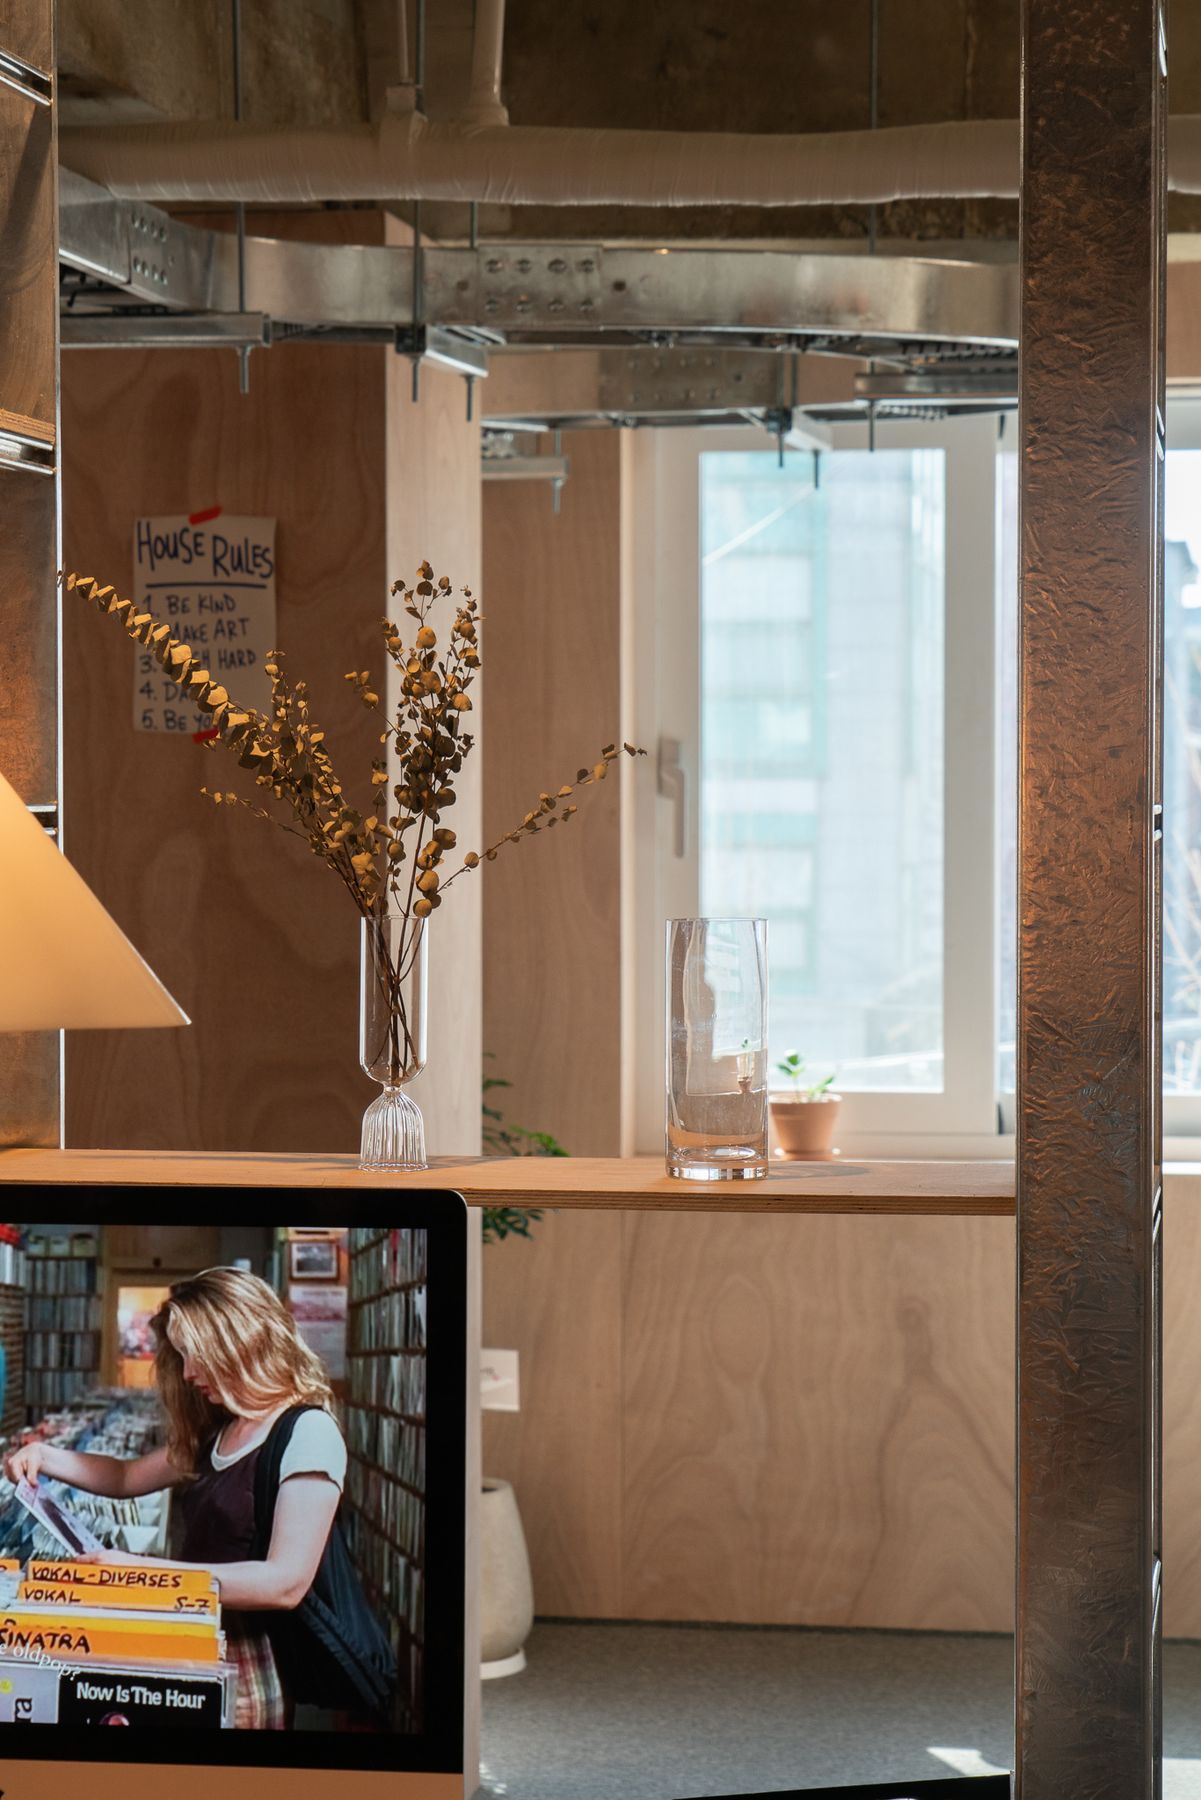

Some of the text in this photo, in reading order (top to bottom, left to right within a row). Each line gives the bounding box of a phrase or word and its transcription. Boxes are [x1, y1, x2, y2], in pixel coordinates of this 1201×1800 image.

[137, 521, 273, 578] HOUSE RULES
[166, 594, 190, 615] BE
[198, 593, 236, 615] KIND
[170, 618, 250, 643] MAKE ART
[139, 655, 157, 674] 3.
[217, 648, 256, 670] HARD
[139, 681, 158, 700] 4.
[142, 708, 158, 730] 5.
[163, 709, 187, 731] BE
[24, 1588, 81, 1603] VOKAL
[76, 1682, 206, 1709] Now Is The Hour
